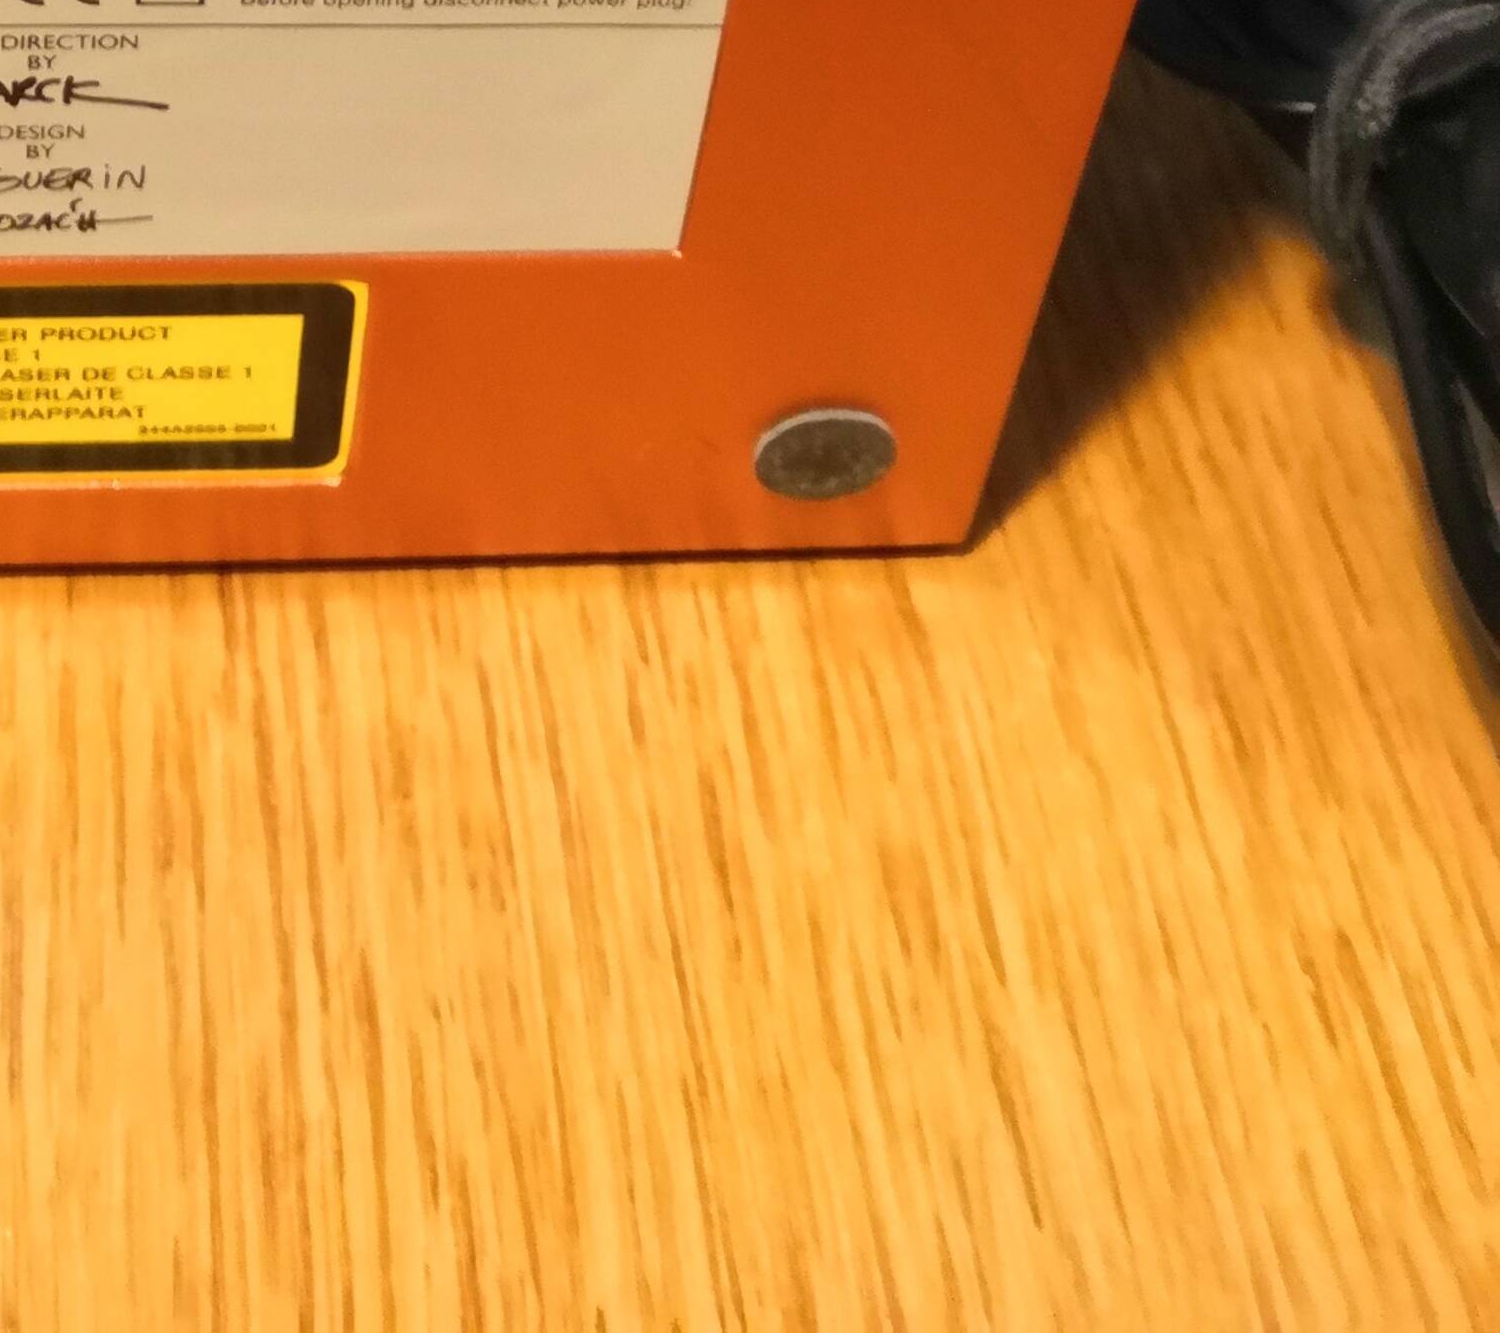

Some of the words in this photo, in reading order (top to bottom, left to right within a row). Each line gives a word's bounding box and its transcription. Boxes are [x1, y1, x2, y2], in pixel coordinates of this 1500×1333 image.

[0, 34, 140, 51] DIRECTION
[27, 54, 57, 70] BY
[26, 143, 55, 159] BY
[40, 325, 172, 342] PRODUCT
[32, 348, 41, 362] 1
[81, 366, 117, 382] DE
[126, 365, 232, 381] CLASSE
[243, 365, 252, 379] 1
